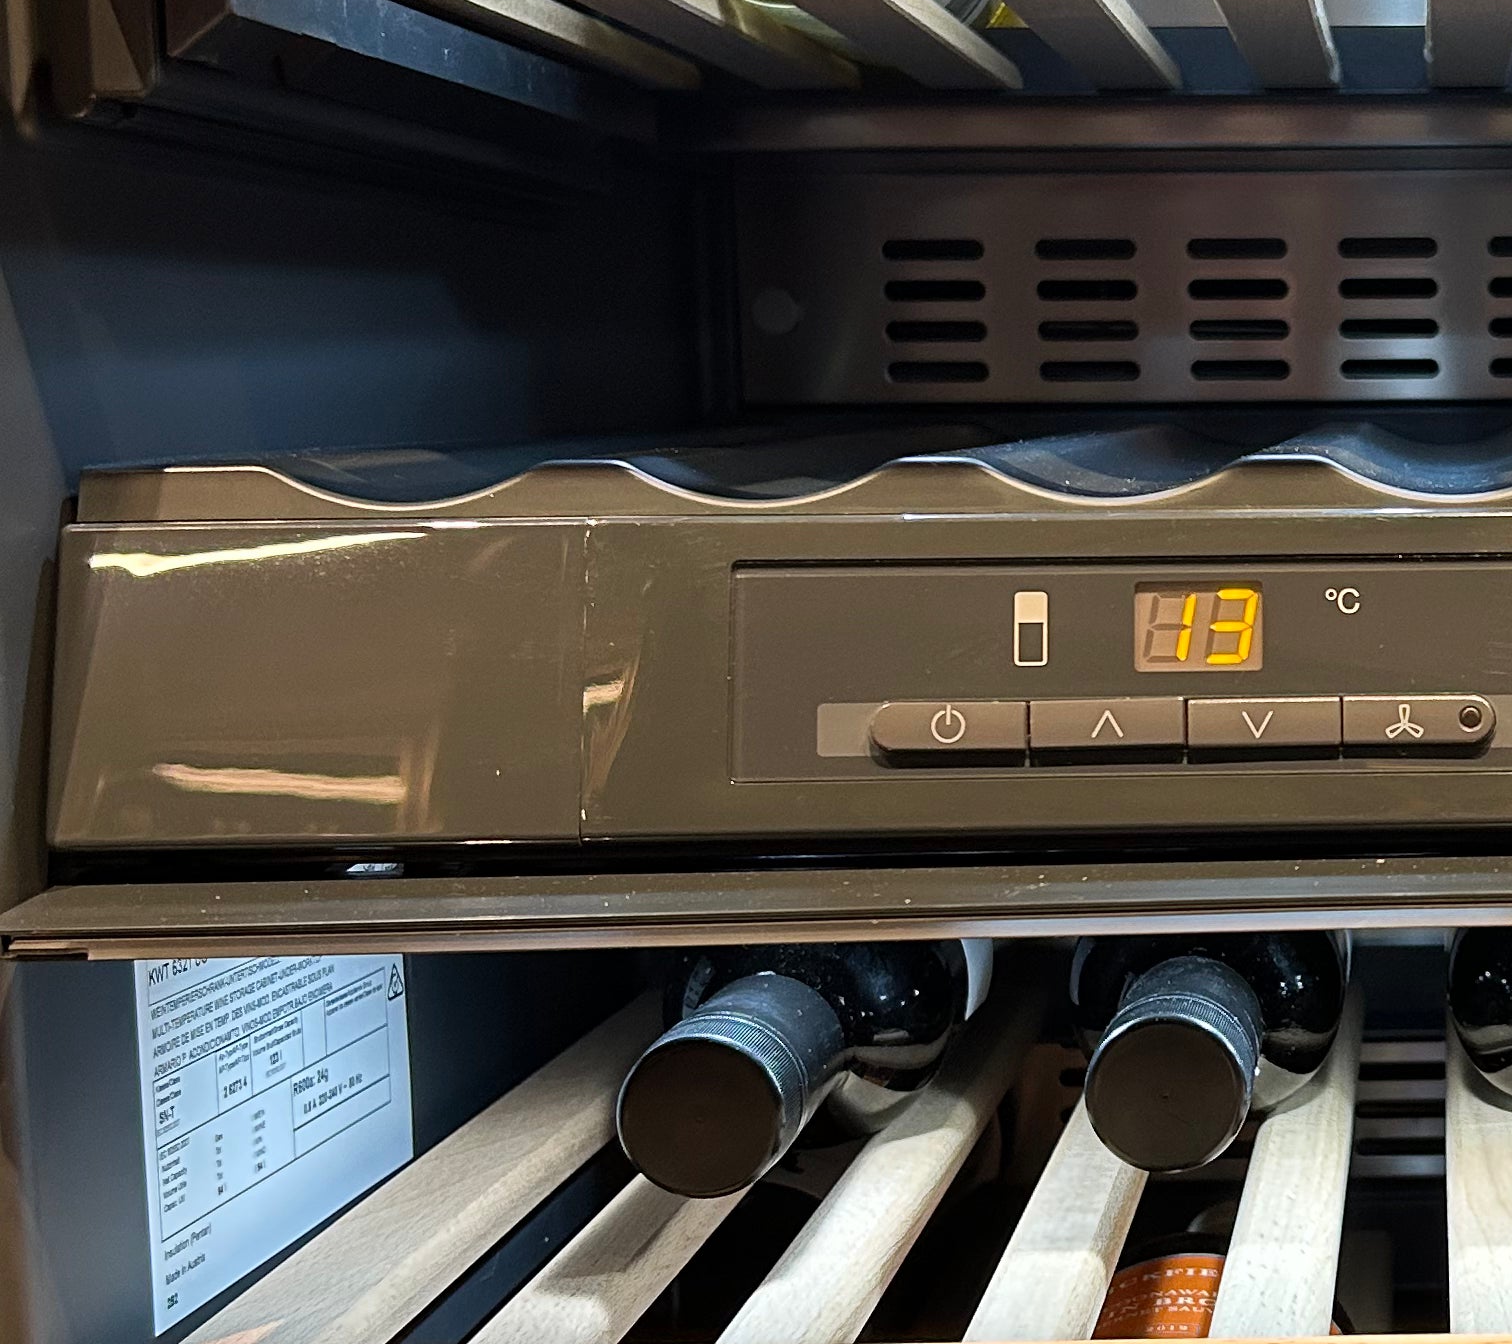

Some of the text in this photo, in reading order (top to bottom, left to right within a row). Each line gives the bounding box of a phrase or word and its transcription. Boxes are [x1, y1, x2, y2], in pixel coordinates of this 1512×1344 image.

[1325, 587, 1361, 615] °C
[1176, 587, 1258, 665] 13
[148, 962, 170, 987] KWT
[214, 994, 230, 1011] WINE
[229, 981, 256, 1004] STORAGE
[180, 1031, 190, 1046] DE
